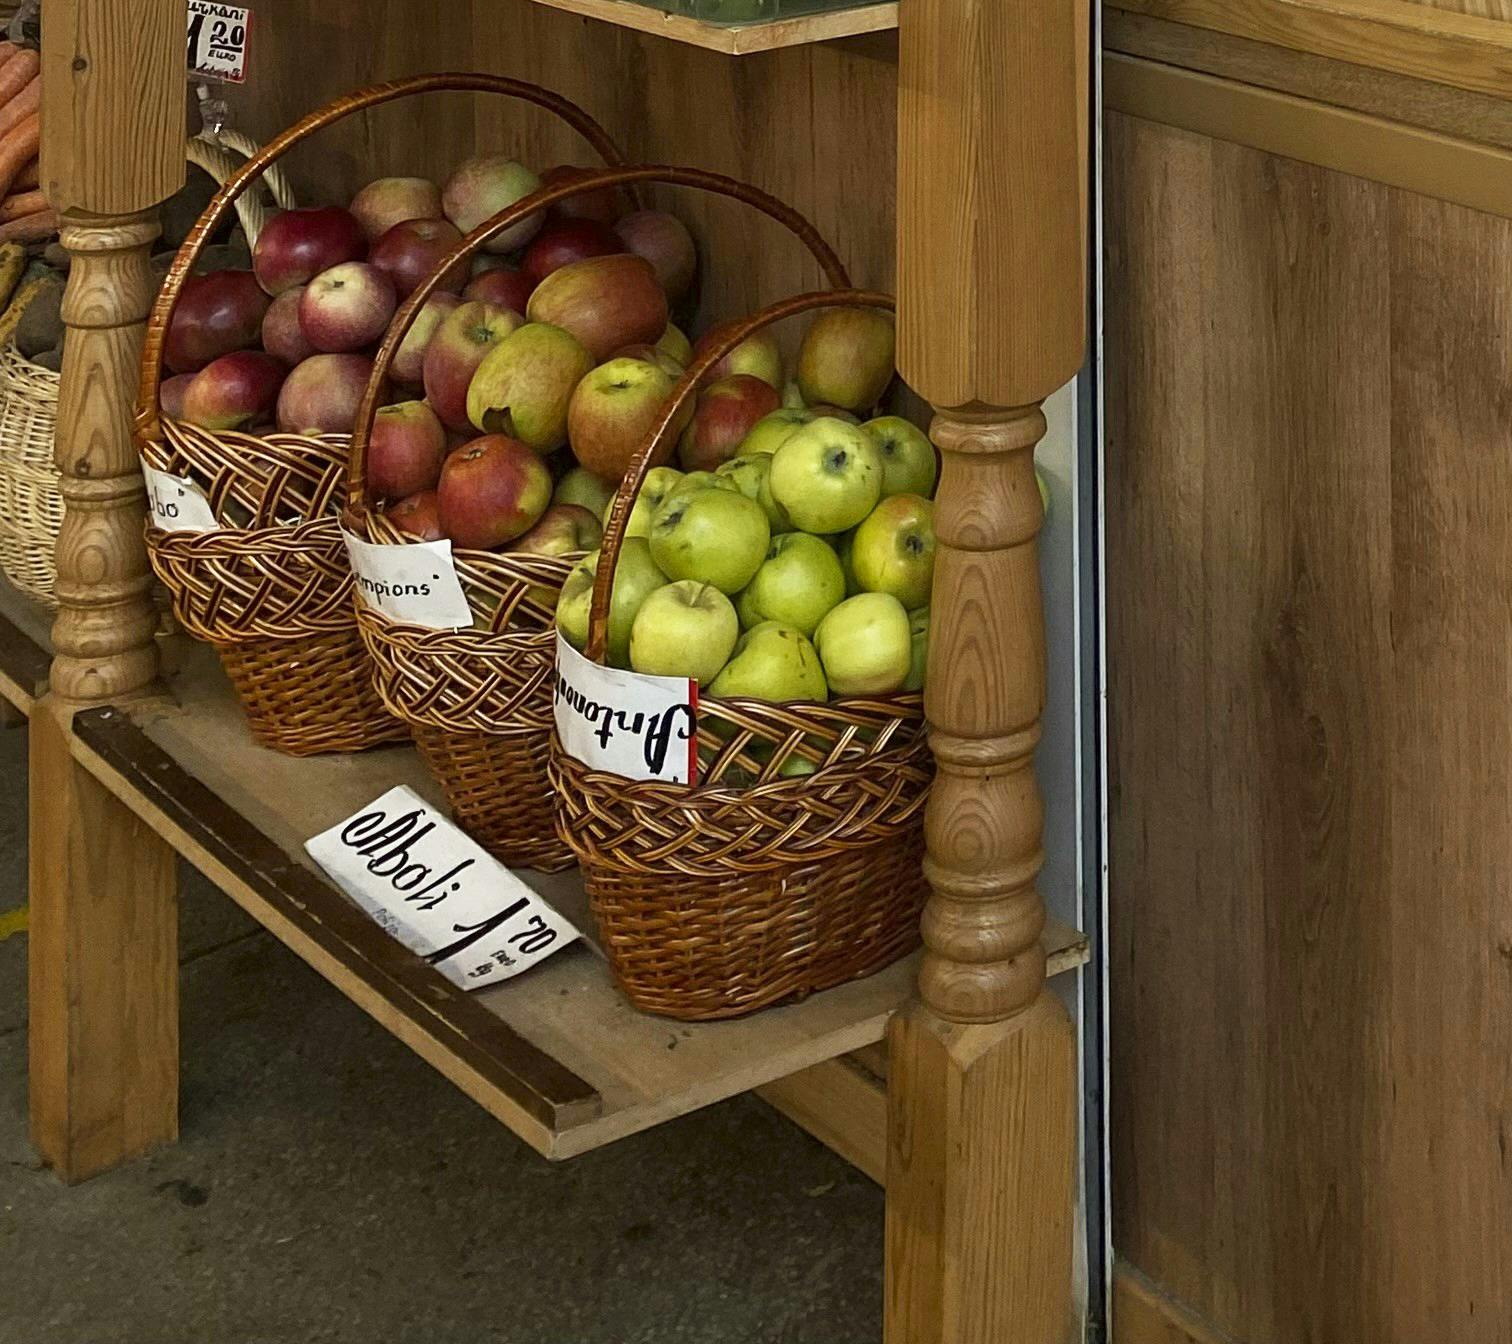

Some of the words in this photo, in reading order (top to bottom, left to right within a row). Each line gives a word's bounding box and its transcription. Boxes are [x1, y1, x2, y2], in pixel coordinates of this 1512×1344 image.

[187, 13, 206, 69] 1
[210, 20, 245, 46] 20
[207, 49, 237, 62] EURO
[424, 897, 531, 965] 1
[508, 915, 557, 954] 70
